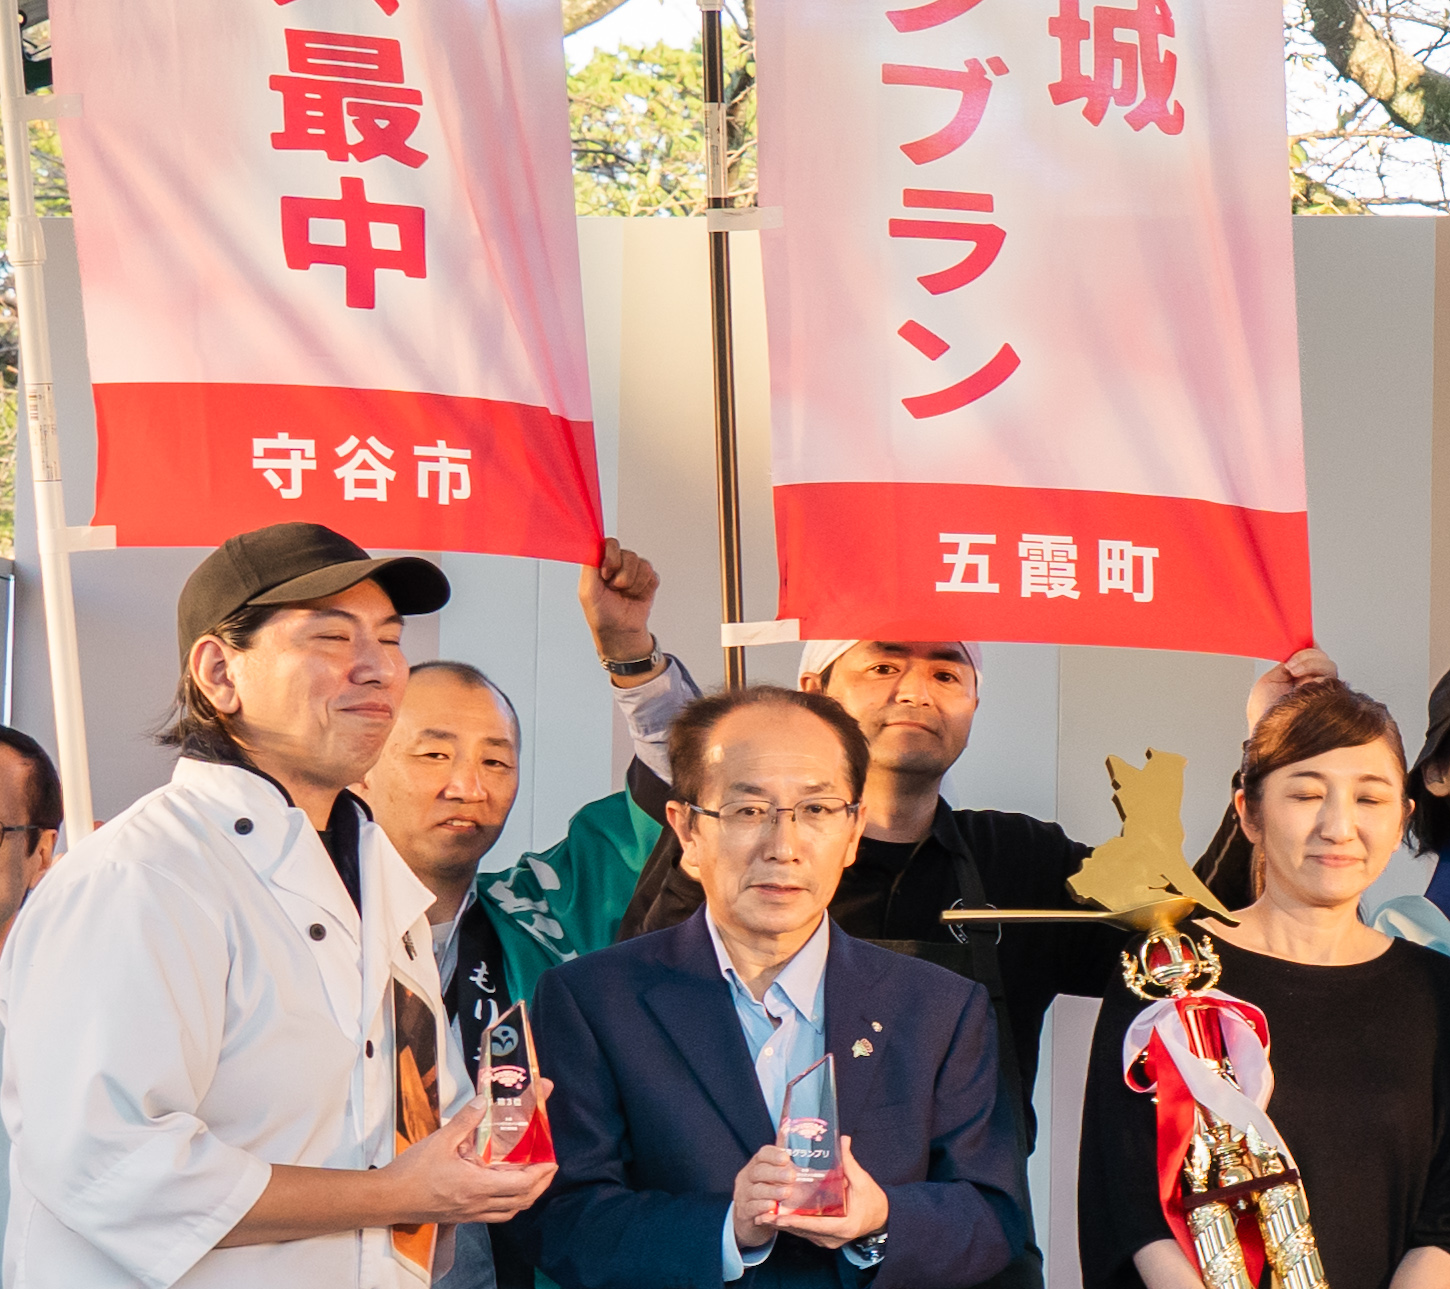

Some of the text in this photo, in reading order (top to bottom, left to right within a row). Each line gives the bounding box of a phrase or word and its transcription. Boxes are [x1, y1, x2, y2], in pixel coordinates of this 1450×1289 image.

[252, 432, 472, 505] 守谷市
[935, 532, 1160, 602] 五霞町
